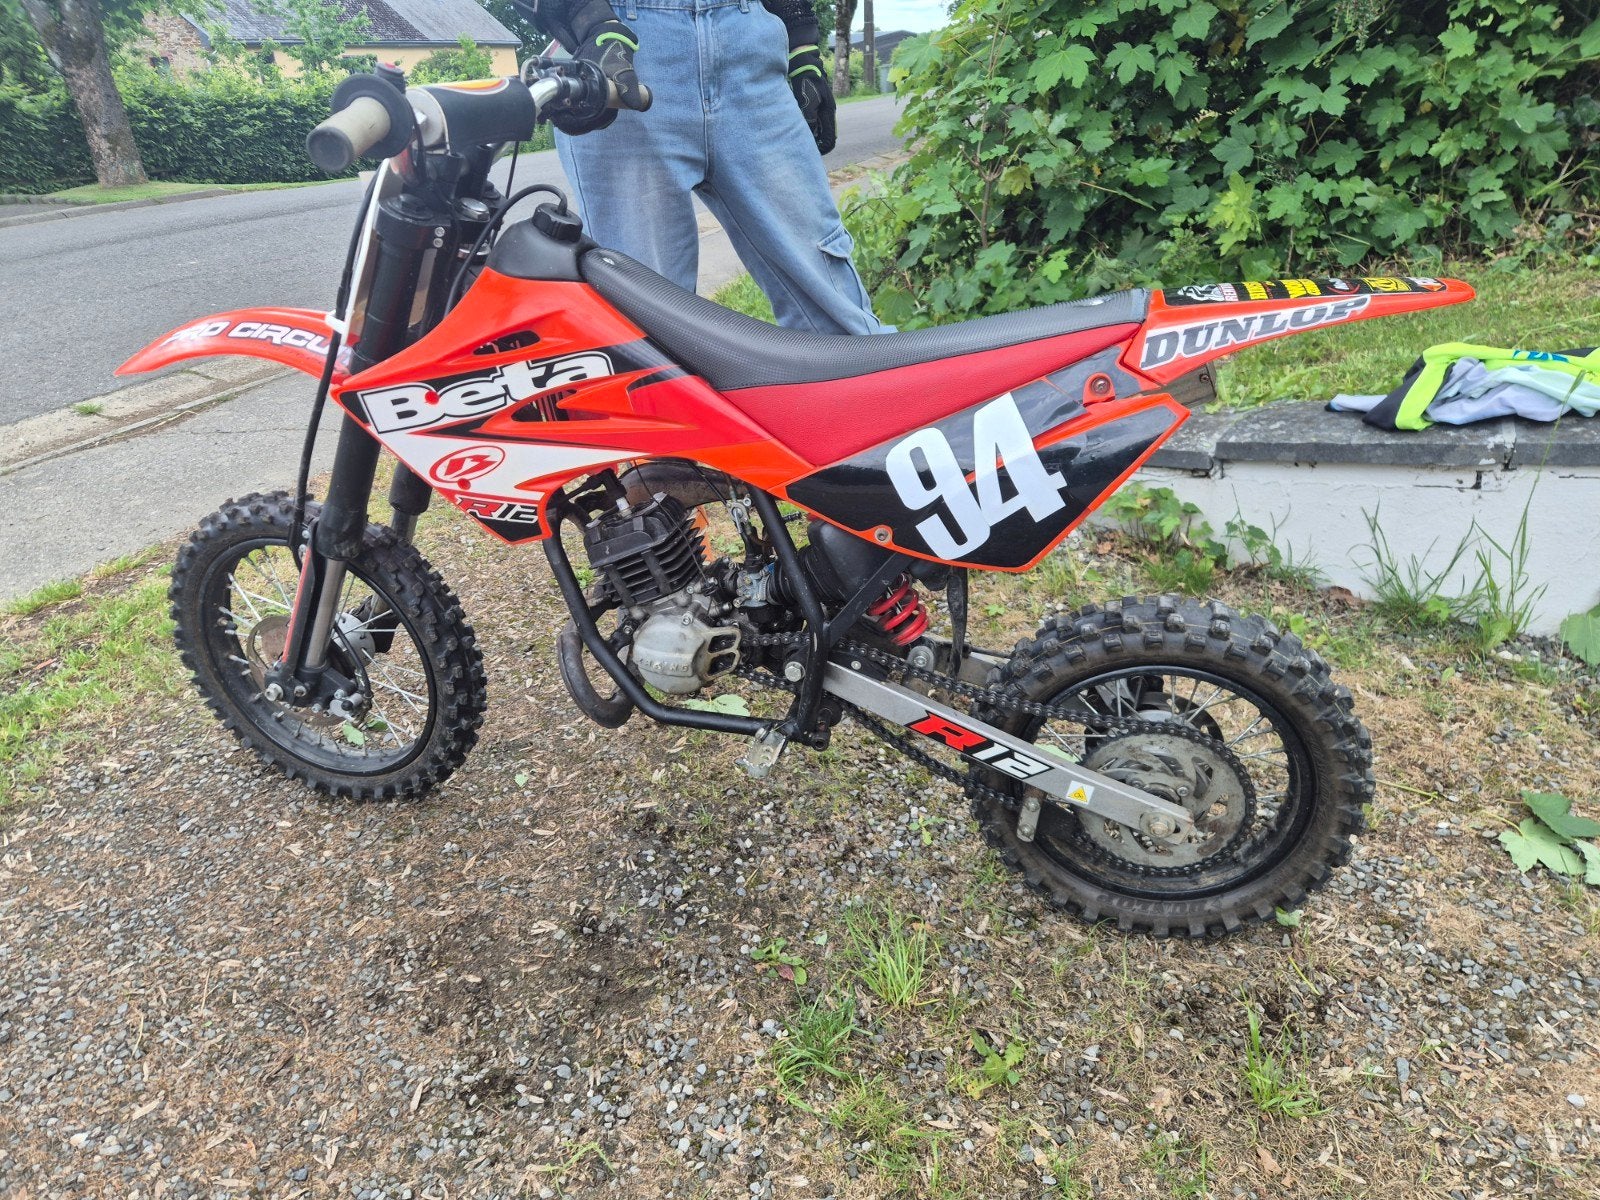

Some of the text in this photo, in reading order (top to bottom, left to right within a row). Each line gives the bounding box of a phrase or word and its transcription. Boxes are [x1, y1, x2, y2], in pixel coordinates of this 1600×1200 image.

[1139, 296, 1370, 370] DUNLOP
[358, 352, 613, 434] Beta
[886, 392, 1068, 560] 94
[904, 709, 1055, 780] R12
